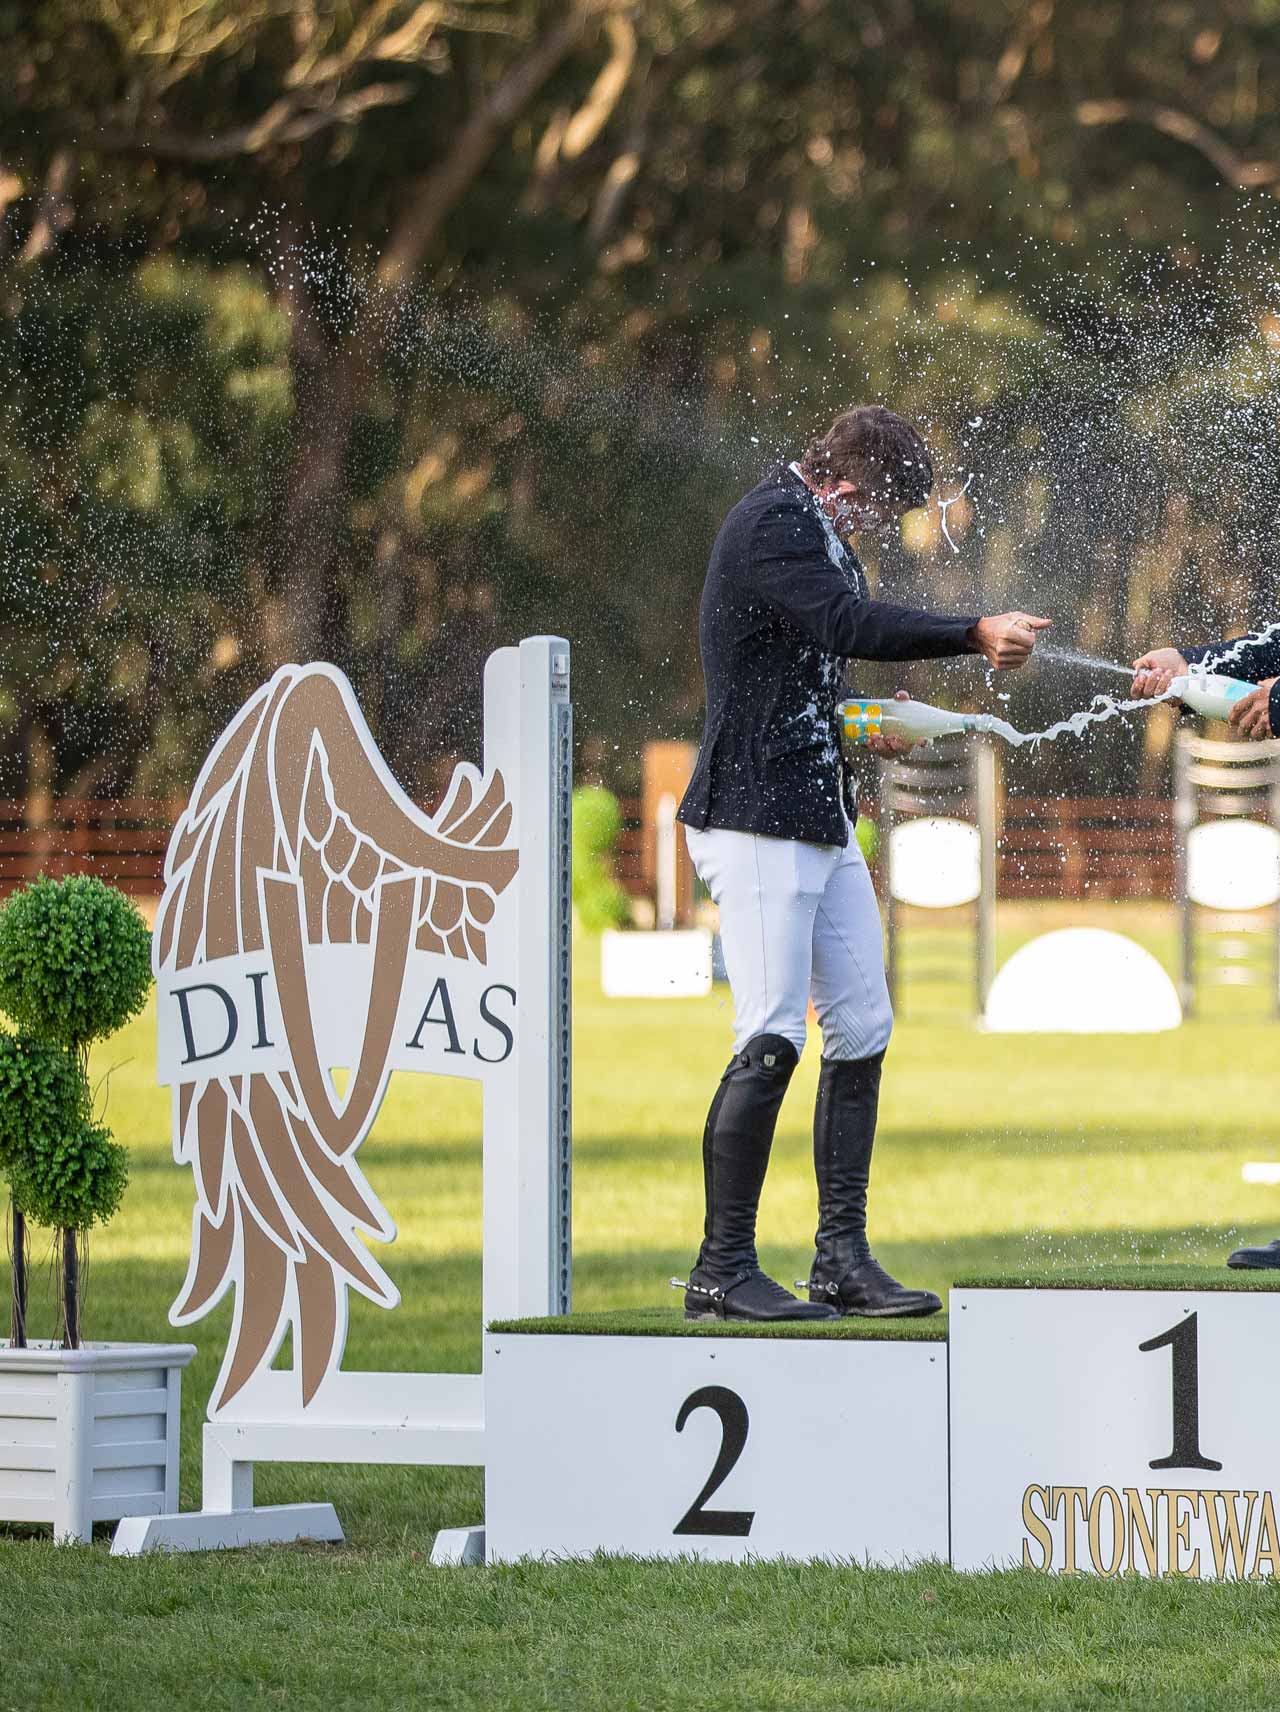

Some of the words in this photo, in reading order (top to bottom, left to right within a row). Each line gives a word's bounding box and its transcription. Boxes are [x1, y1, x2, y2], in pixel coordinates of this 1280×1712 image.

[169, 876, 517, 1157] DIVAS
[672, 1385, 755, 1536] 2
[1139, 1311, 1222, 1471] 1
